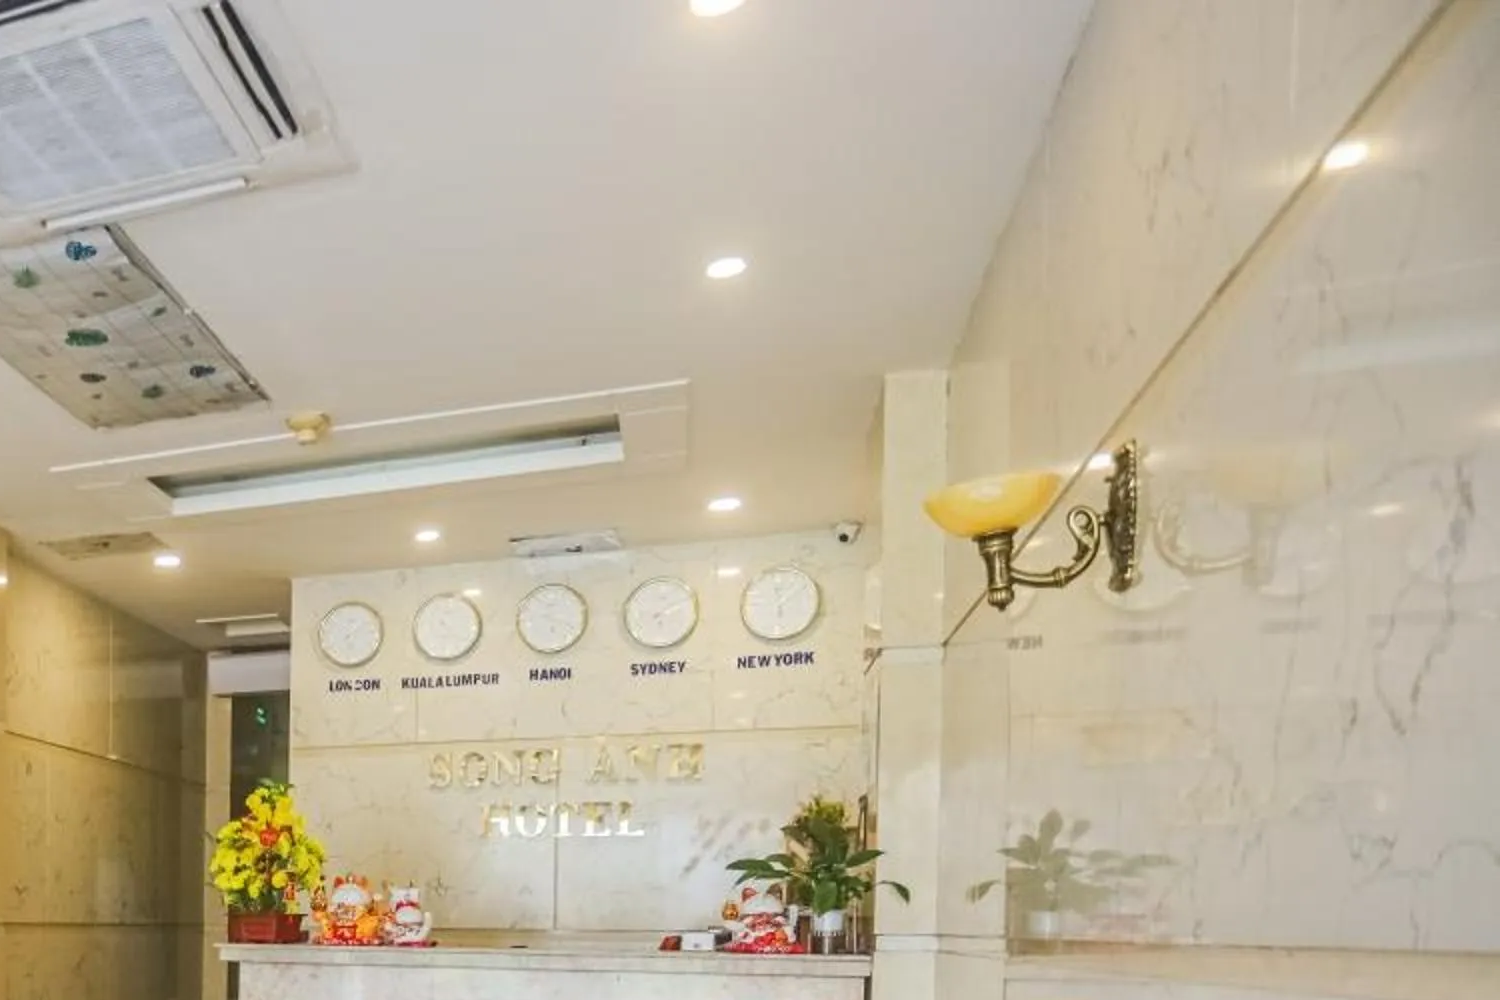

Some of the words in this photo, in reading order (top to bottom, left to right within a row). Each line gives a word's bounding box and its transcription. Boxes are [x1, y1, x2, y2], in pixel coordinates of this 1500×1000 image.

[737, 655, 771, 669] NEW
[775, 651, 815, 666] YORK
[529, 667, 572, 681] HANOI
[631, 661, 686, 676] SYDNEY
[329, 679, 381, 693] LONDON
[428, 748, 560, 790] SONG
[481, 801, 645, 838] HOTEL
